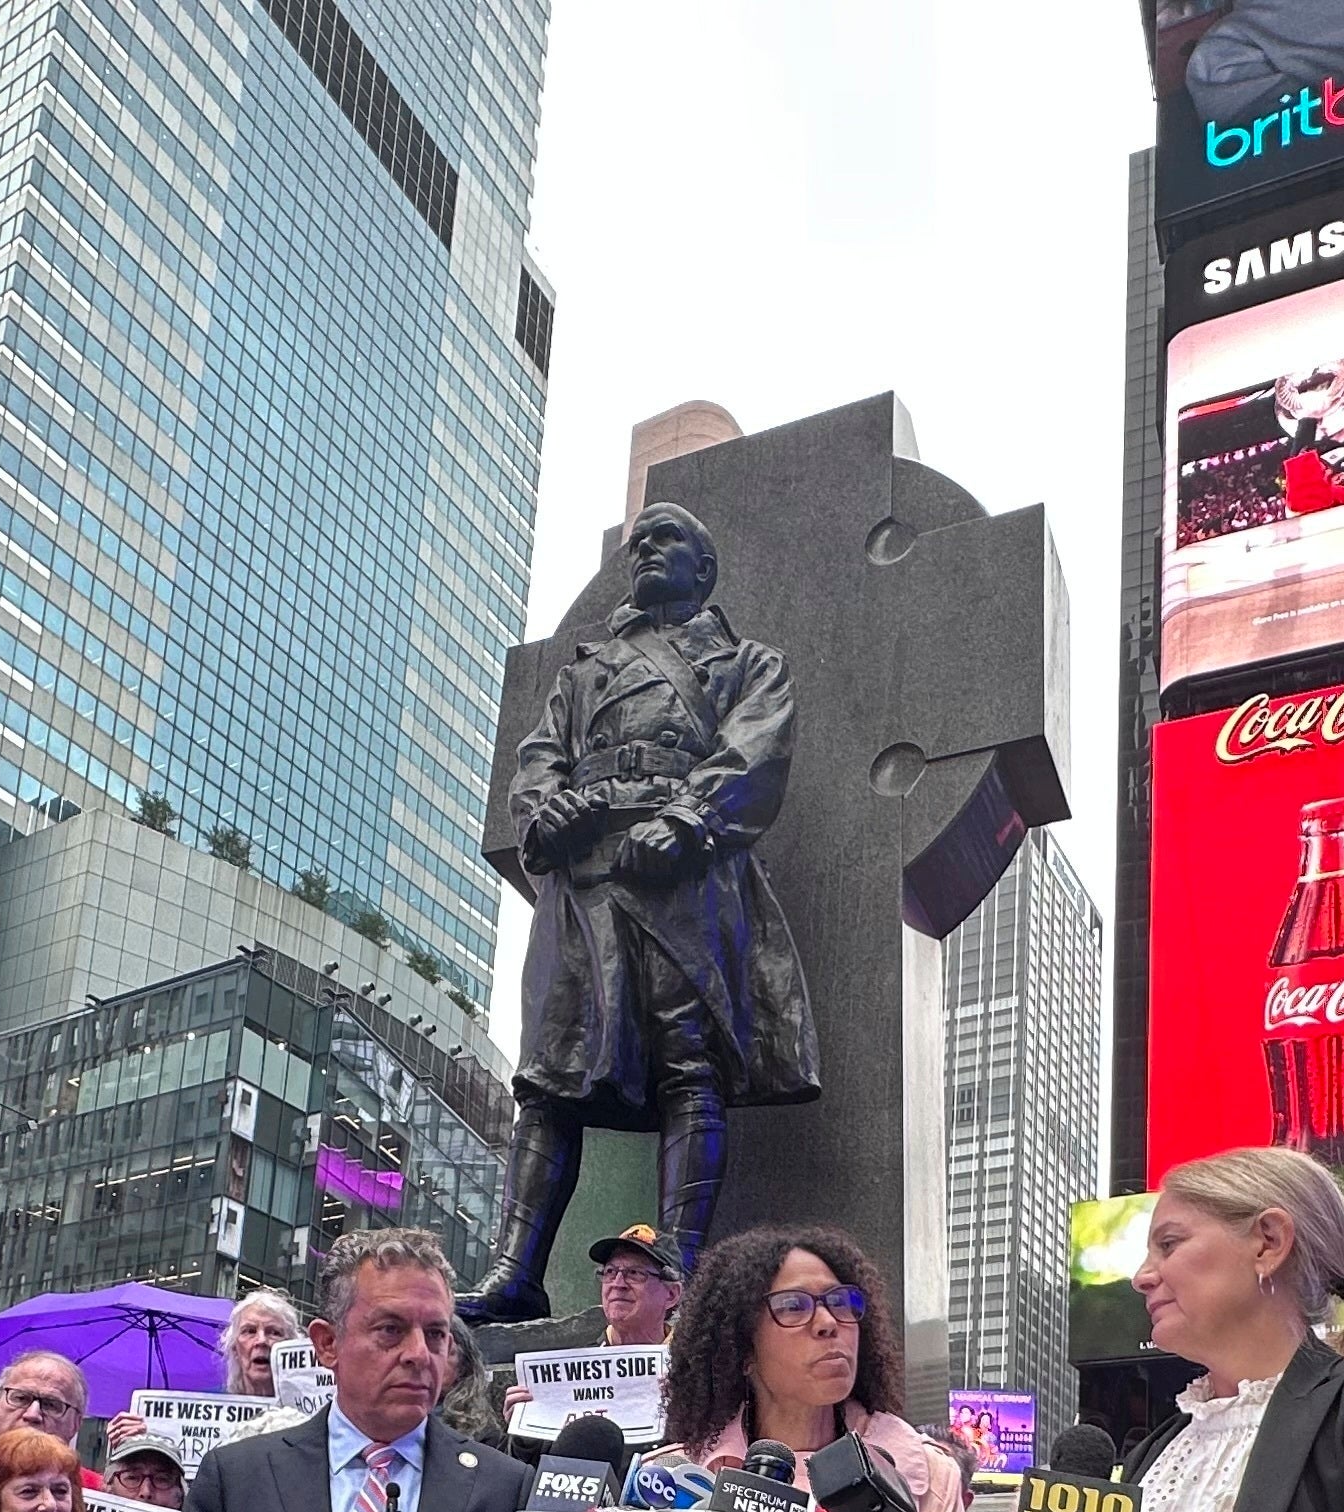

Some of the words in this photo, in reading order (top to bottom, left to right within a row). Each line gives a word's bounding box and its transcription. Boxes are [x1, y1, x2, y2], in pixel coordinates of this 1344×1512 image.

[281, 1351, 306, 1370] THE
[529, 1362, 562, 1384] THE
[564, 1359, 612, 1382] WEST
[616, 1356, 657, 1379] SIDE
[573, 1386, 615, 1401] WANTS
[144, 1400, 173, 1419] THE
[177, 1402, 223, 1422] WEST
[181, 1425, 221, 1439] WANTS
[536, 1489, 560, 1499] NEW
[565, 1491, 595, 1503] YORK
[638, 1471, 677, 1501] abc
[722, 1482, 788, 1509] SPECTRUM
